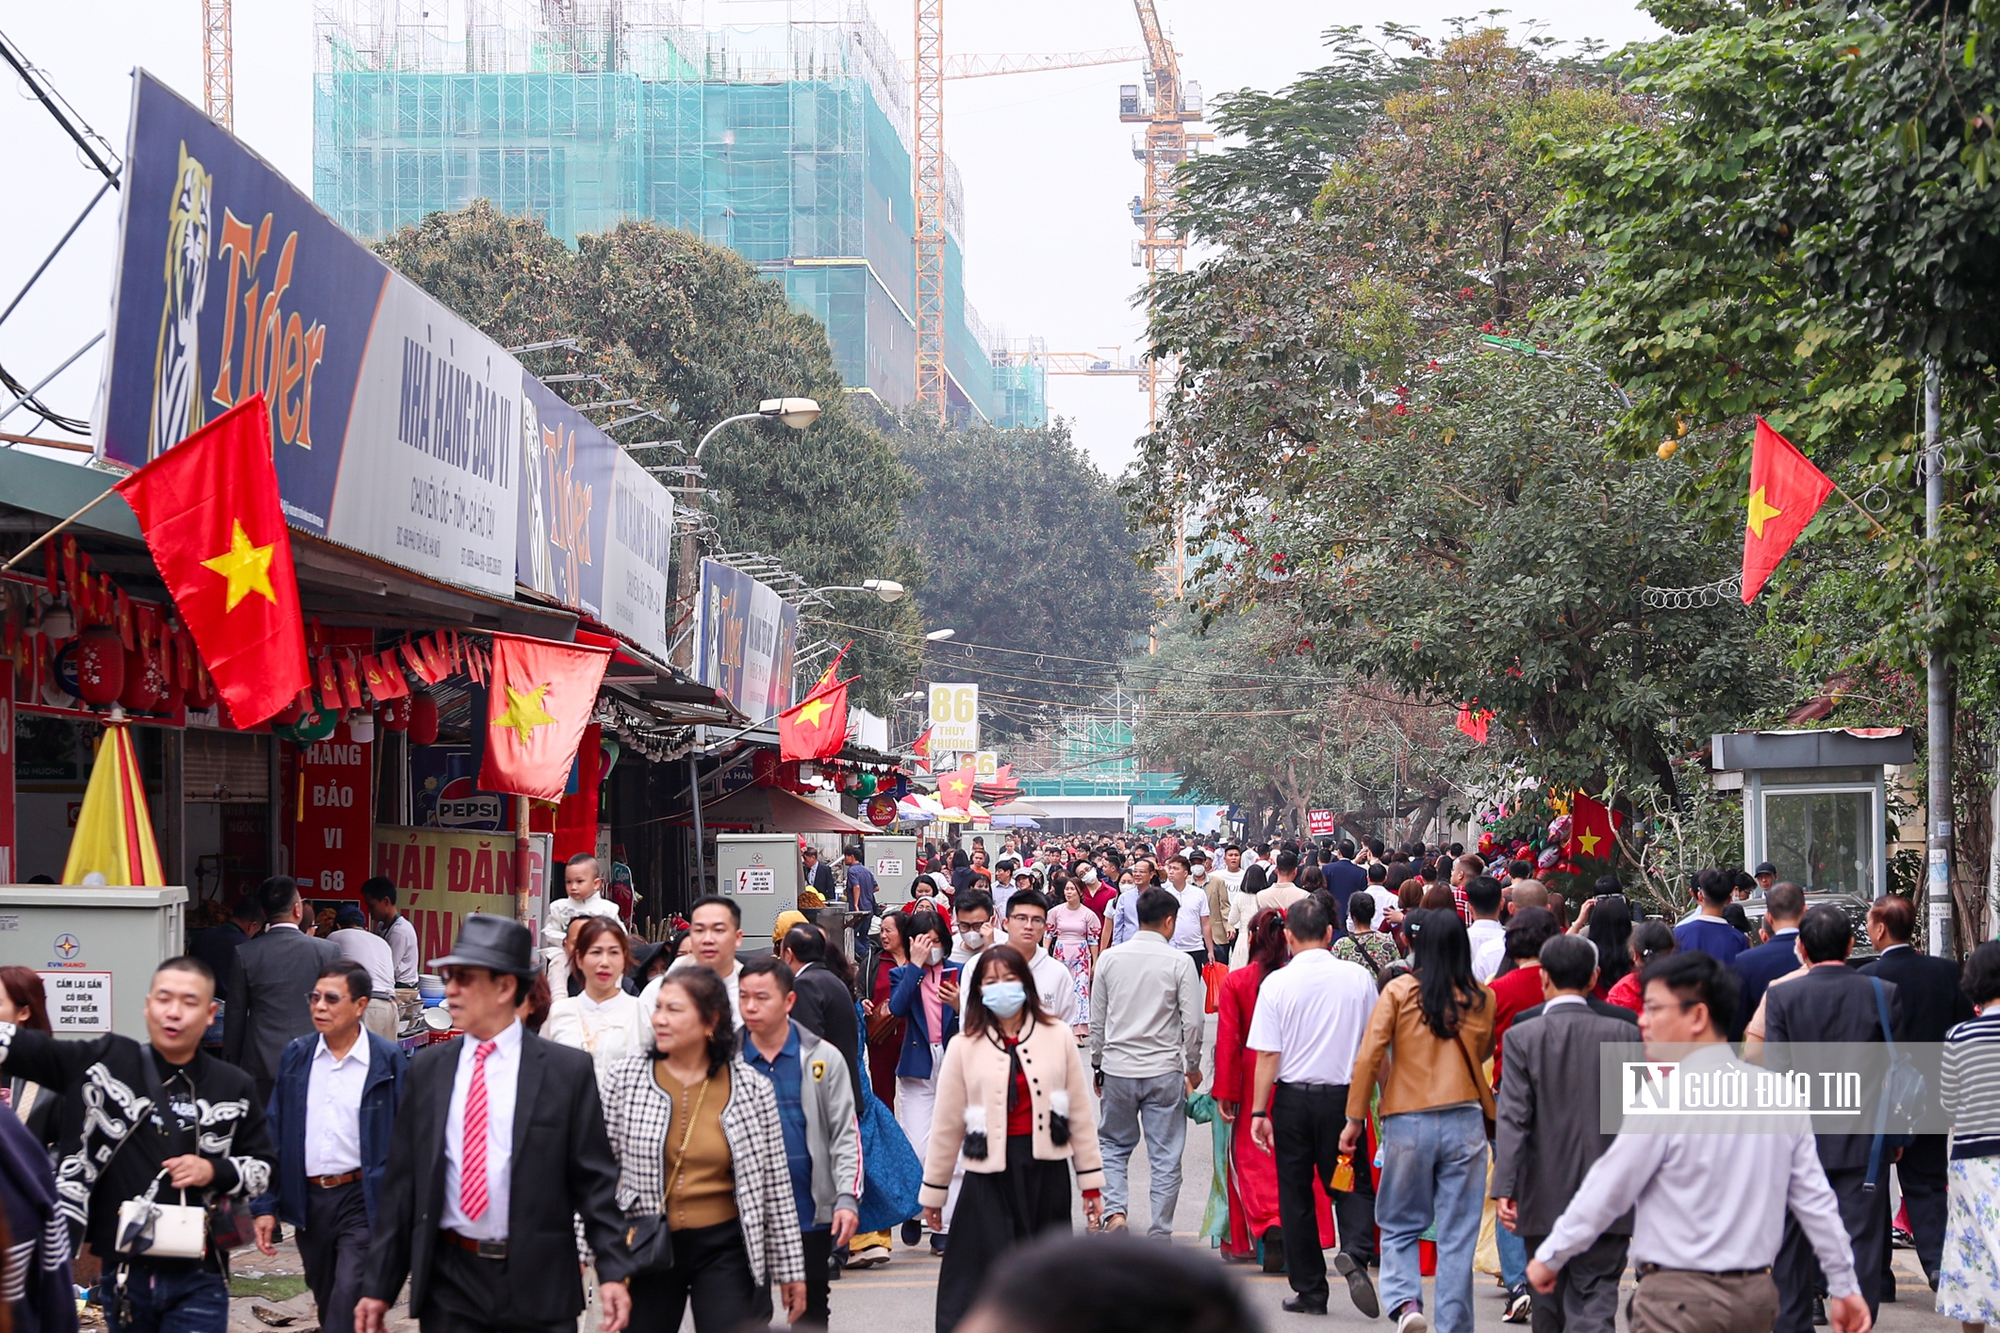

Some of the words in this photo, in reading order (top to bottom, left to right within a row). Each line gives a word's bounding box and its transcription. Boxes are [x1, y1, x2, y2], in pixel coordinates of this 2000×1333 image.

[212, 206, 326, 461] Tiger
[398, 324, 431, 453] NHÀ
[433, 338, 472, 471] HÀNG
[472, 355, 497, 483] BẢO
[499, 396, 511, 489] VI
[440, 477, 449, 525] ỐC
[453, 486, 466, 530] TÔM
[542, 422, 593, 608] Tiger
[931, 687, 975, 723] 86
[306, 740, 362, 766] HÀNG
[930, 737, 974, 750] PHƯƠNG
[961, 753, 995, 775] 86
[733, 770, 754, 780] HÀN
[313, 779, 354, 808] BẢO
[439, 802, 498, 817] PEPSI
[1310, 811, 1331, 821] WC
[323, 828, 342, 849] VI
[376, 833, 436, 890] HẢI
[447, 841, 543, 897] ĐĂNG
[320, 870, 345, 891] 68
[400, 893, 453, 975] ÚN
[56, 978, 72, 988] CẤM
[74, 981, 85, 990] LẠI
[66, 993, 75, 1001] CÓ
[76, 993, 93, 1003] ĐIỆN
[81, 1003, 98, 1012] HIỂM
[60, 1015, 77, 1024] CHẾT
[78, 1016, 99, 1024] NGƯỜI
